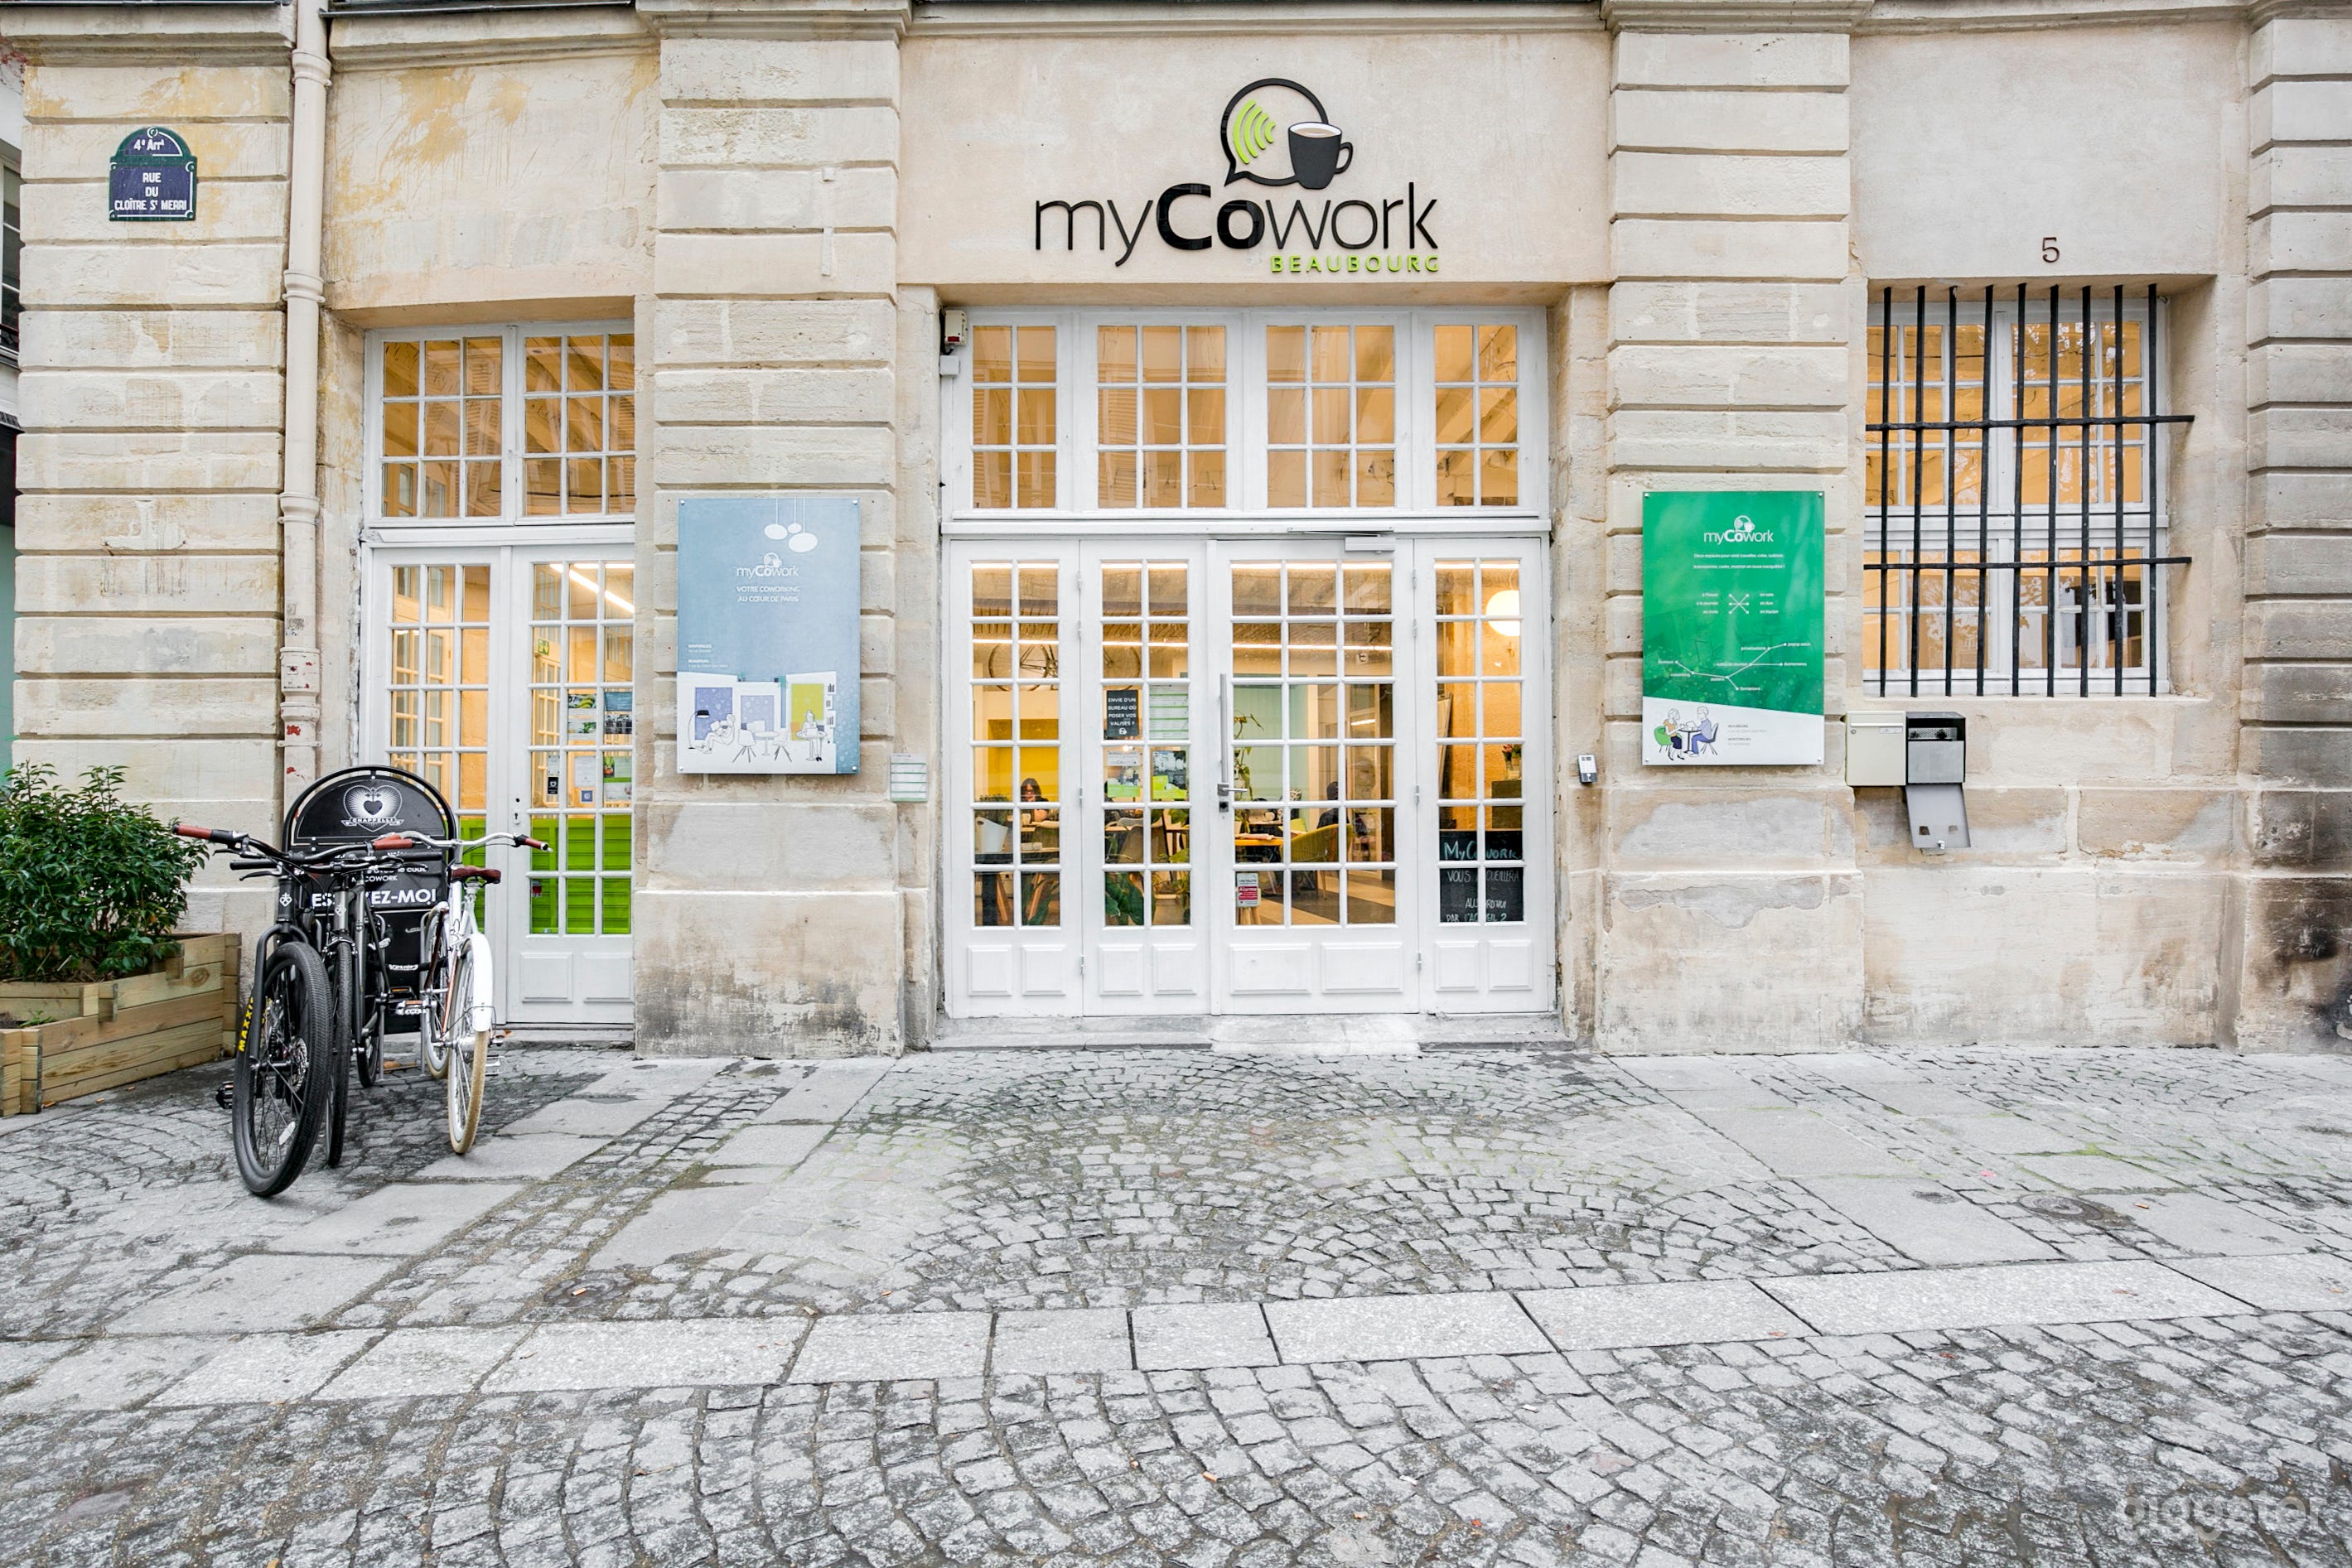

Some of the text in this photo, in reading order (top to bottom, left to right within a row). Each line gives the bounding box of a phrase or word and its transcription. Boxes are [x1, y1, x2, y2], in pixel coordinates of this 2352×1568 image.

[142, 172, 162, 183] RUE
[145, 186, 159, 197] DU
[114, 198, 147, 210] CLOÎTRE
[161, 200, 187, 210] MERRI
[1036, 181, 1438, 267] myCowork
[2042, 237, 2060, 263] 5
[1271, 254, 1439, 273] BEAUBOURG
[1703, 528, 1774, 545] myCowork
[737, 565, 799, 579] myCowork
[1447, 870, 1471, 882] VOUS
